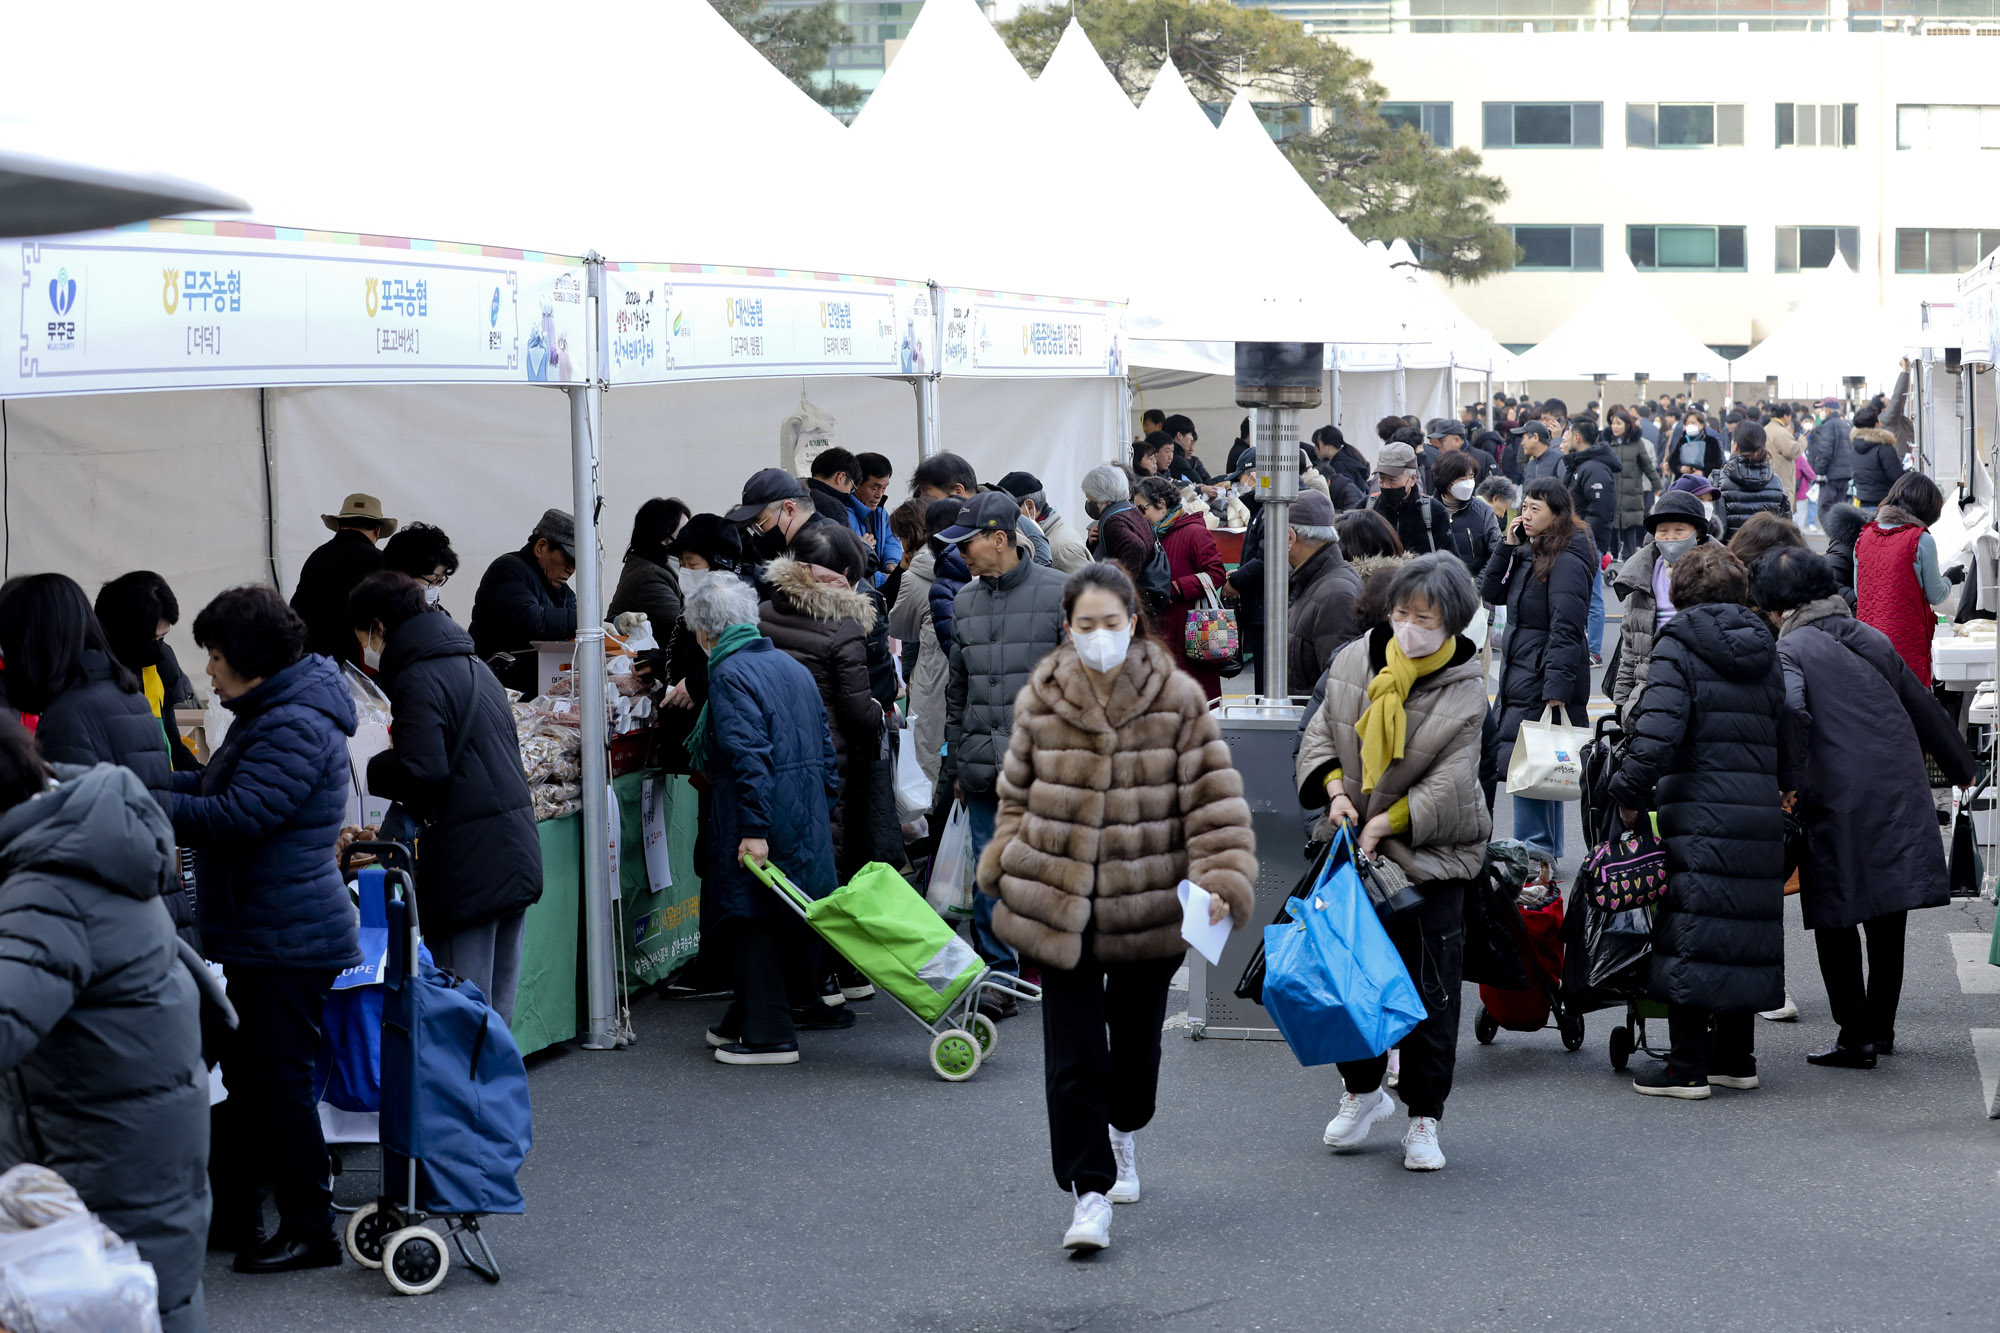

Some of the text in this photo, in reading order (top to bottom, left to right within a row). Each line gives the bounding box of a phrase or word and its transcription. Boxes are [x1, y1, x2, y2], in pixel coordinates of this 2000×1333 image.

[182, 270, 241, 313] 무주농협
[381, 279, 427, 317] 포곡농협
[625, 291, 641, 306] 2024
[735, 298, 763, 328] 대신농협
[827, 302, 851, 329] 단양농협
[47, 322, 75, 341] 무주군
[489, 331, 501, 350] 용인시
[613, 334, 654, 368] 직거래장터
